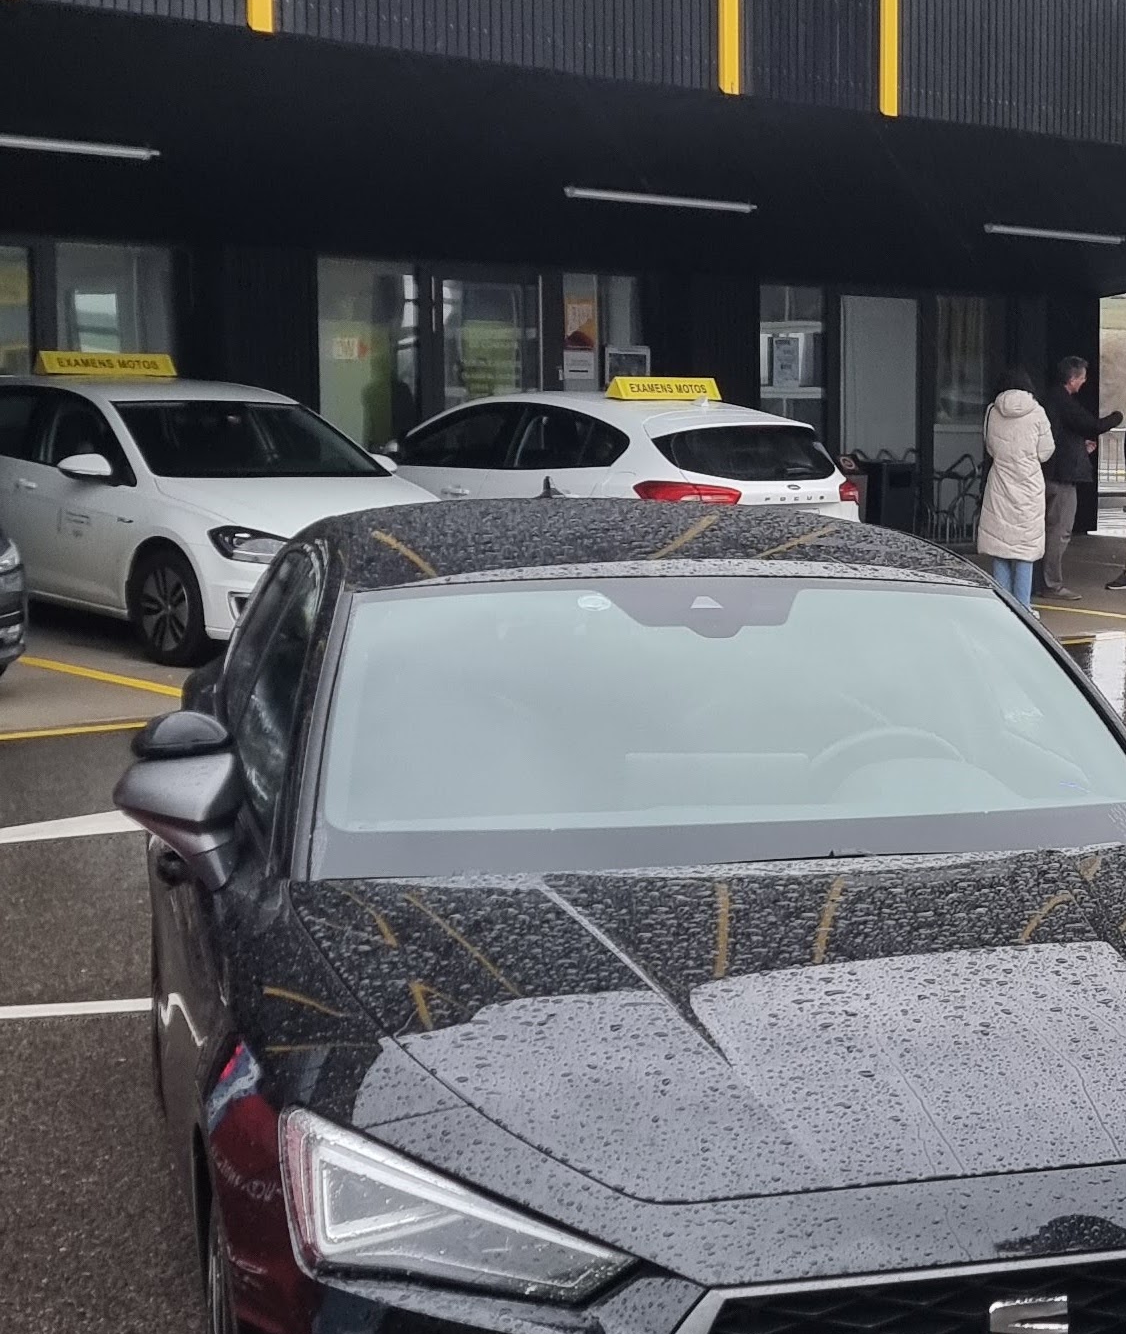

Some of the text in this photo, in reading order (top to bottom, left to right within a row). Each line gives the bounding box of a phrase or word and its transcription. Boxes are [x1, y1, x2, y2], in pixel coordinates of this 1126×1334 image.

[57, 357, 158, 369] EXAMENS MOTOS
[629, 383, 707, 394] EXAMENS MOTOS
